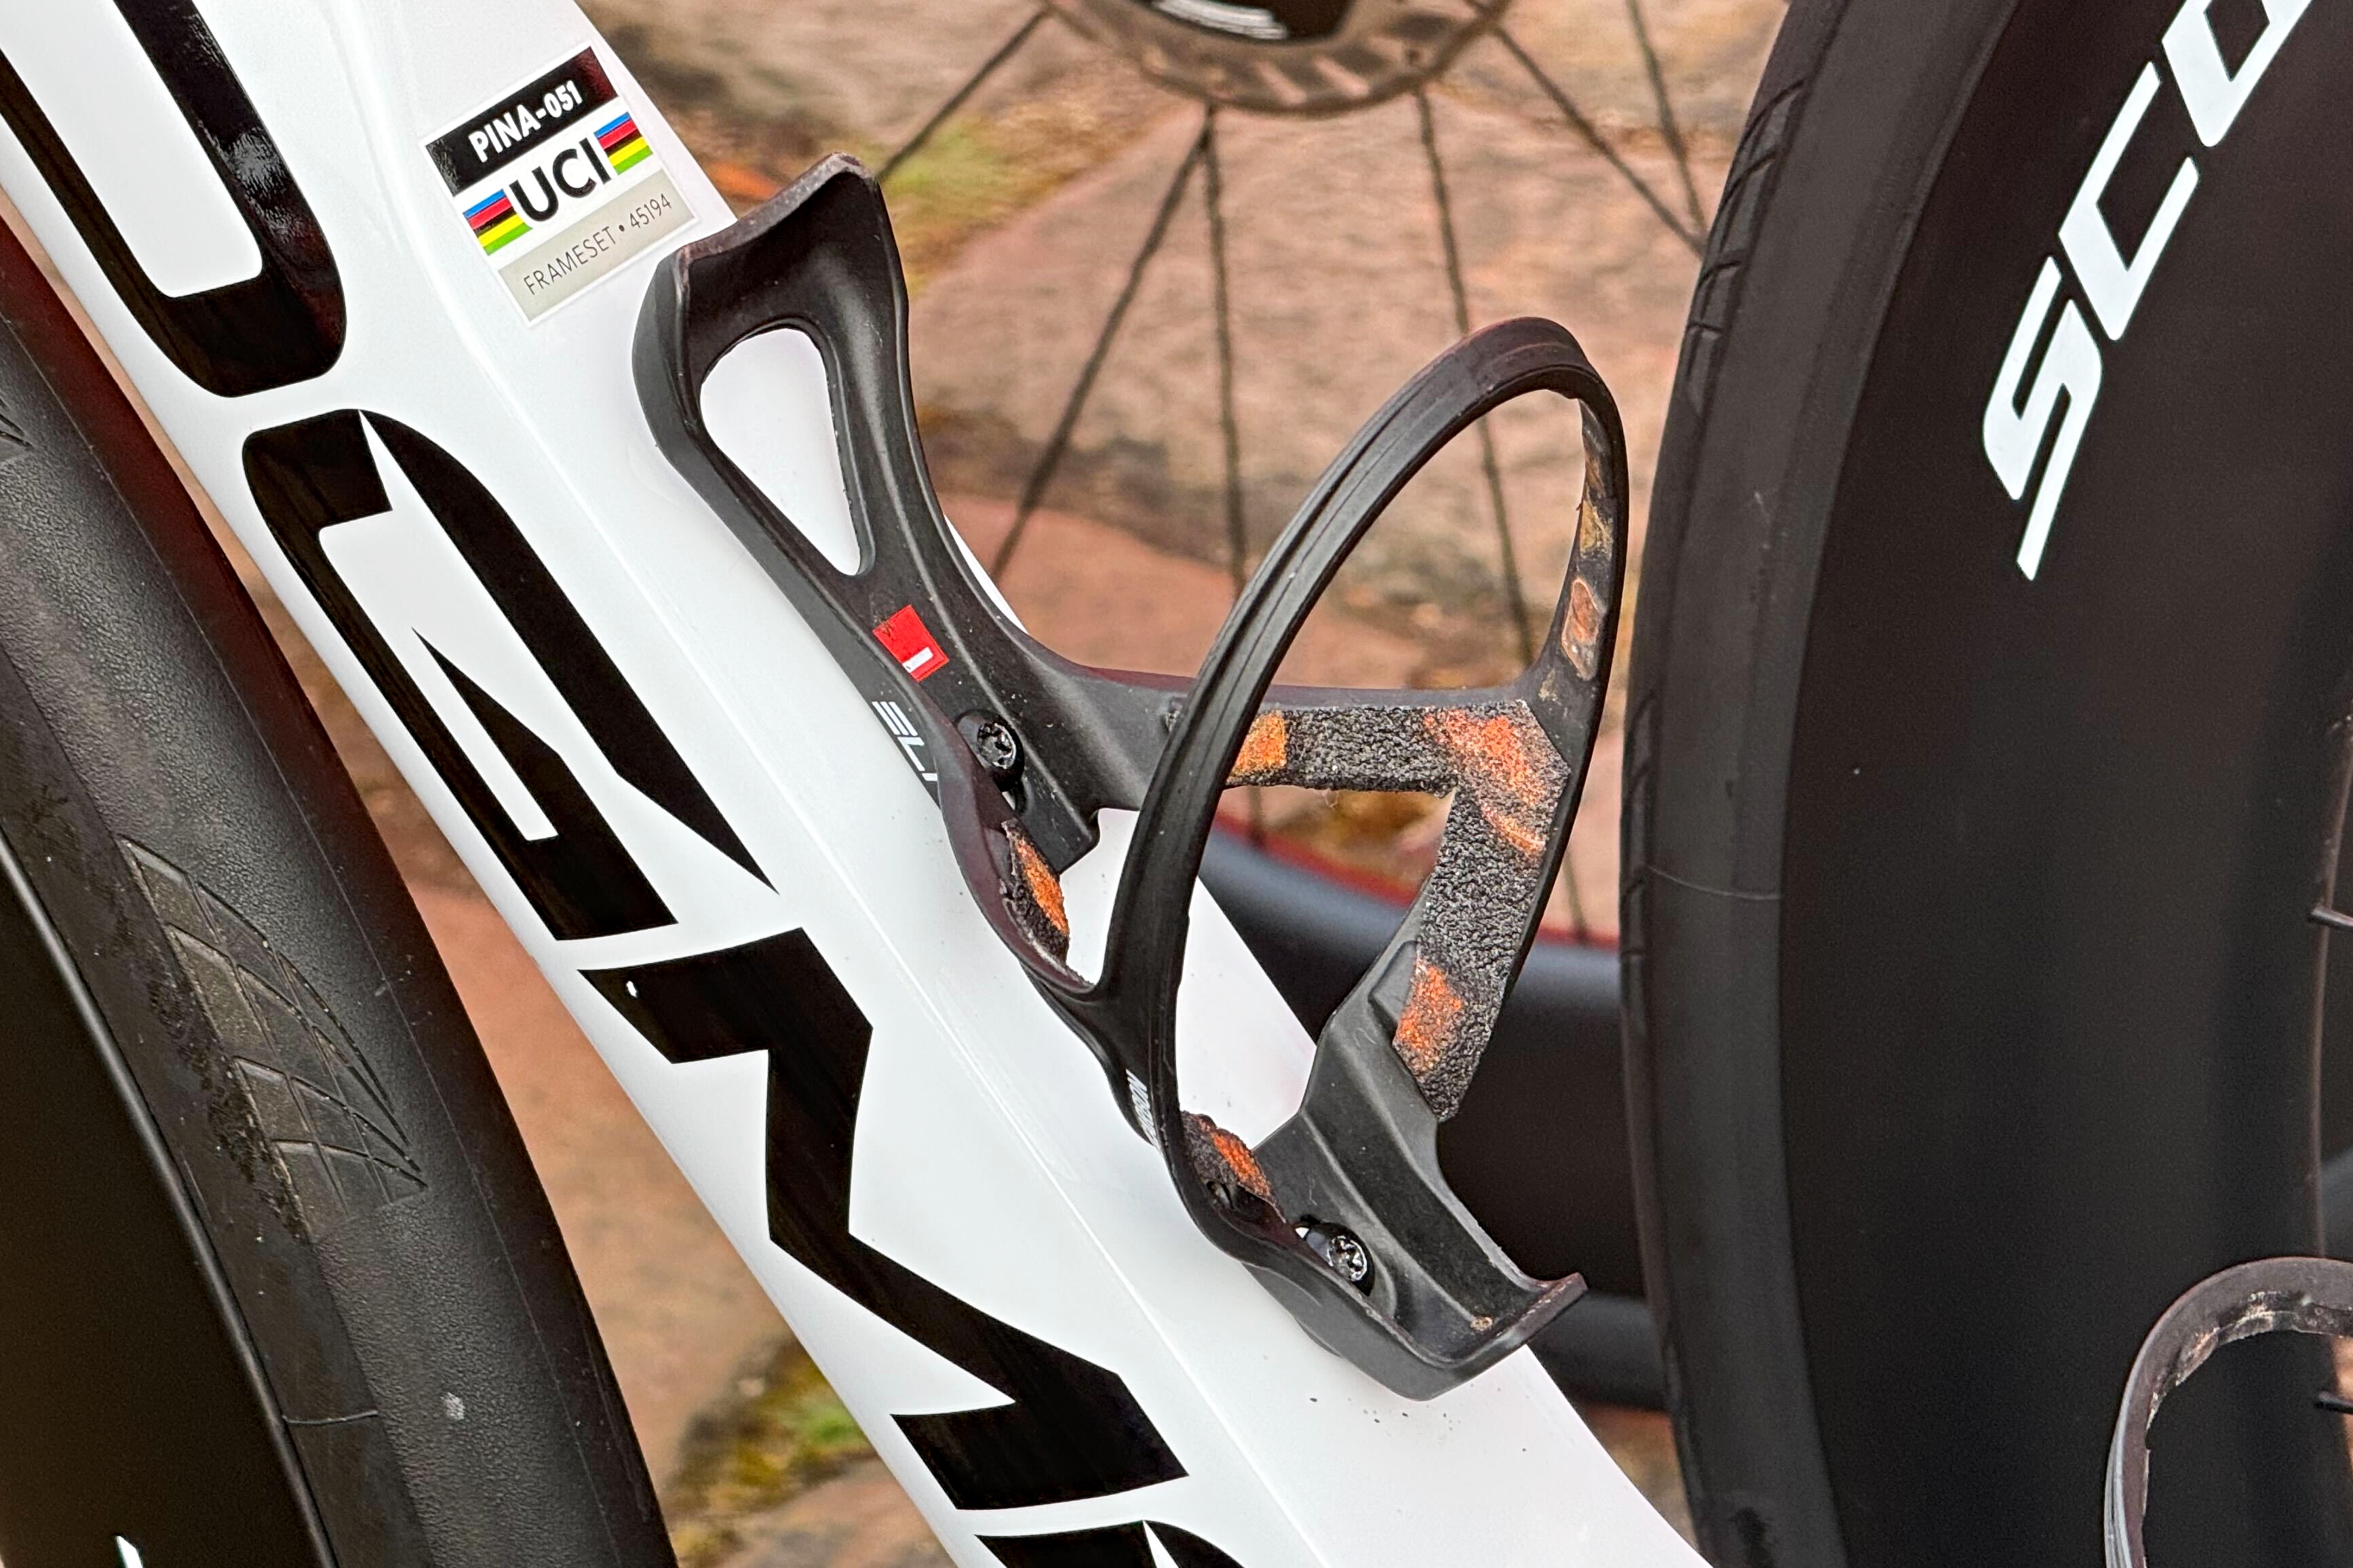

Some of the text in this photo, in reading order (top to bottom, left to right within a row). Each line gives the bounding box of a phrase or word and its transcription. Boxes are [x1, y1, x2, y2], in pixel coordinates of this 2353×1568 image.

[468, 79, 583, 163] PINA-051
[509, 138, 612, 222] UCI
[523, 193, 672, 296] FRAMESET 45194
